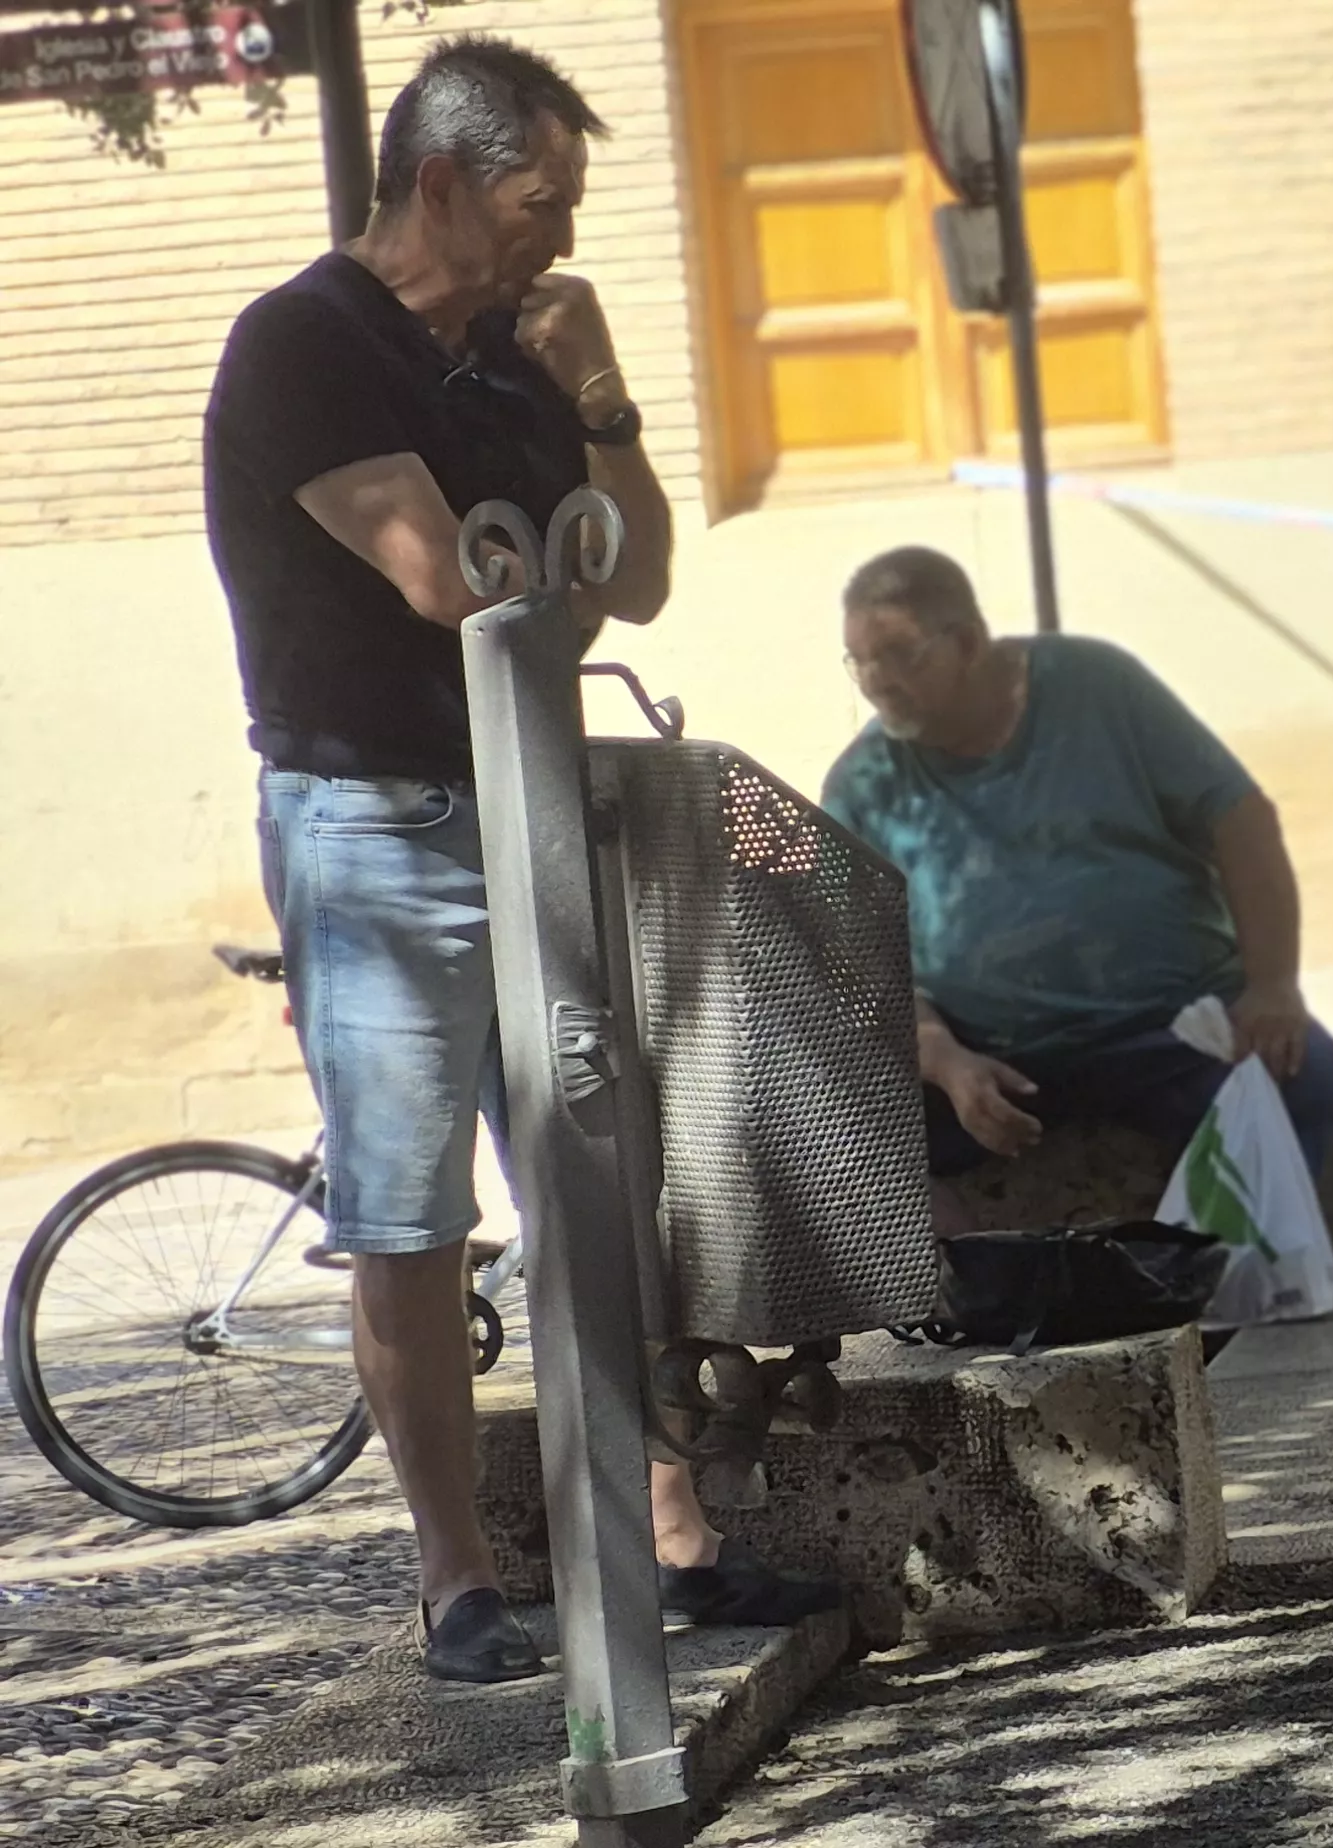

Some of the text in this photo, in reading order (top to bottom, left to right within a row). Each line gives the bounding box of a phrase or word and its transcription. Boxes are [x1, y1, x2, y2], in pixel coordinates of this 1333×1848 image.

[25, 66, 70, 87] San
[76, 61, 143, 82] Pedro
[149, 56, 168, 75] el
